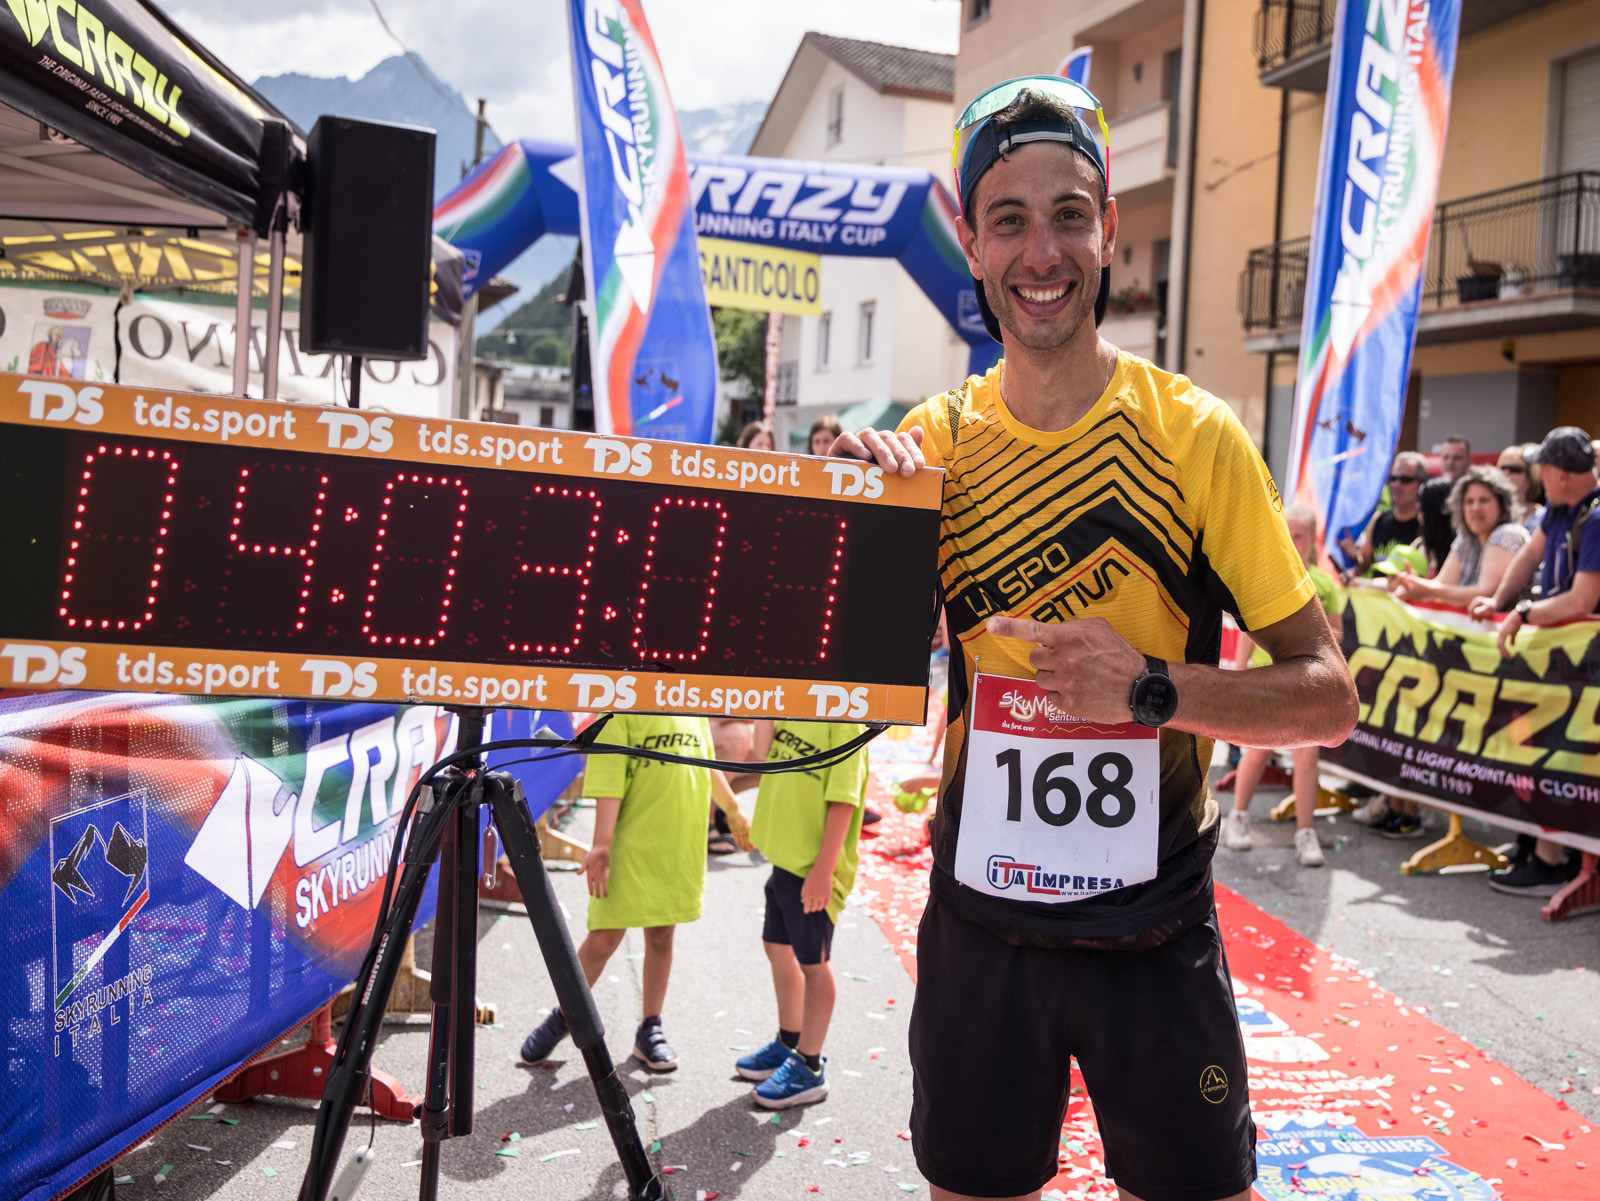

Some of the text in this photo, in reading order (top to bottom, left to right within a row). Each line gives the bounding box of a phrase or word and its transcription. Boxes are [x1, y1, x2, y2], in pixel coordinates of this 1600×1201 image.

[37, 54, 56, 73] THE
[689, 164, 909, 226] RAZY
[779, 219, 838, 242] ITALY
[840, 225, 887, 246] CUP
[18, 379, 885, 499] TDS tds.sport TDS tds.sport TDS tds.sport TDS
[998, 542, 1071, 605] SPO
[0, 643, 869, 720] TDS tds.sport TDS tds.sport TDS tds.sport TDS
[1001, 719, 1011, 728] the
[995, 748, 1136, 828] 168
[1400, 763, 1474, 798] SINCE 1989
[1404, 746, 1415, 761] &
[1416, 749, 1454, 773] LIGHT
[1453, 760, 1535, 792] MOUNTAIN
[55, 964, 153, 1033] SKYRUNNING
